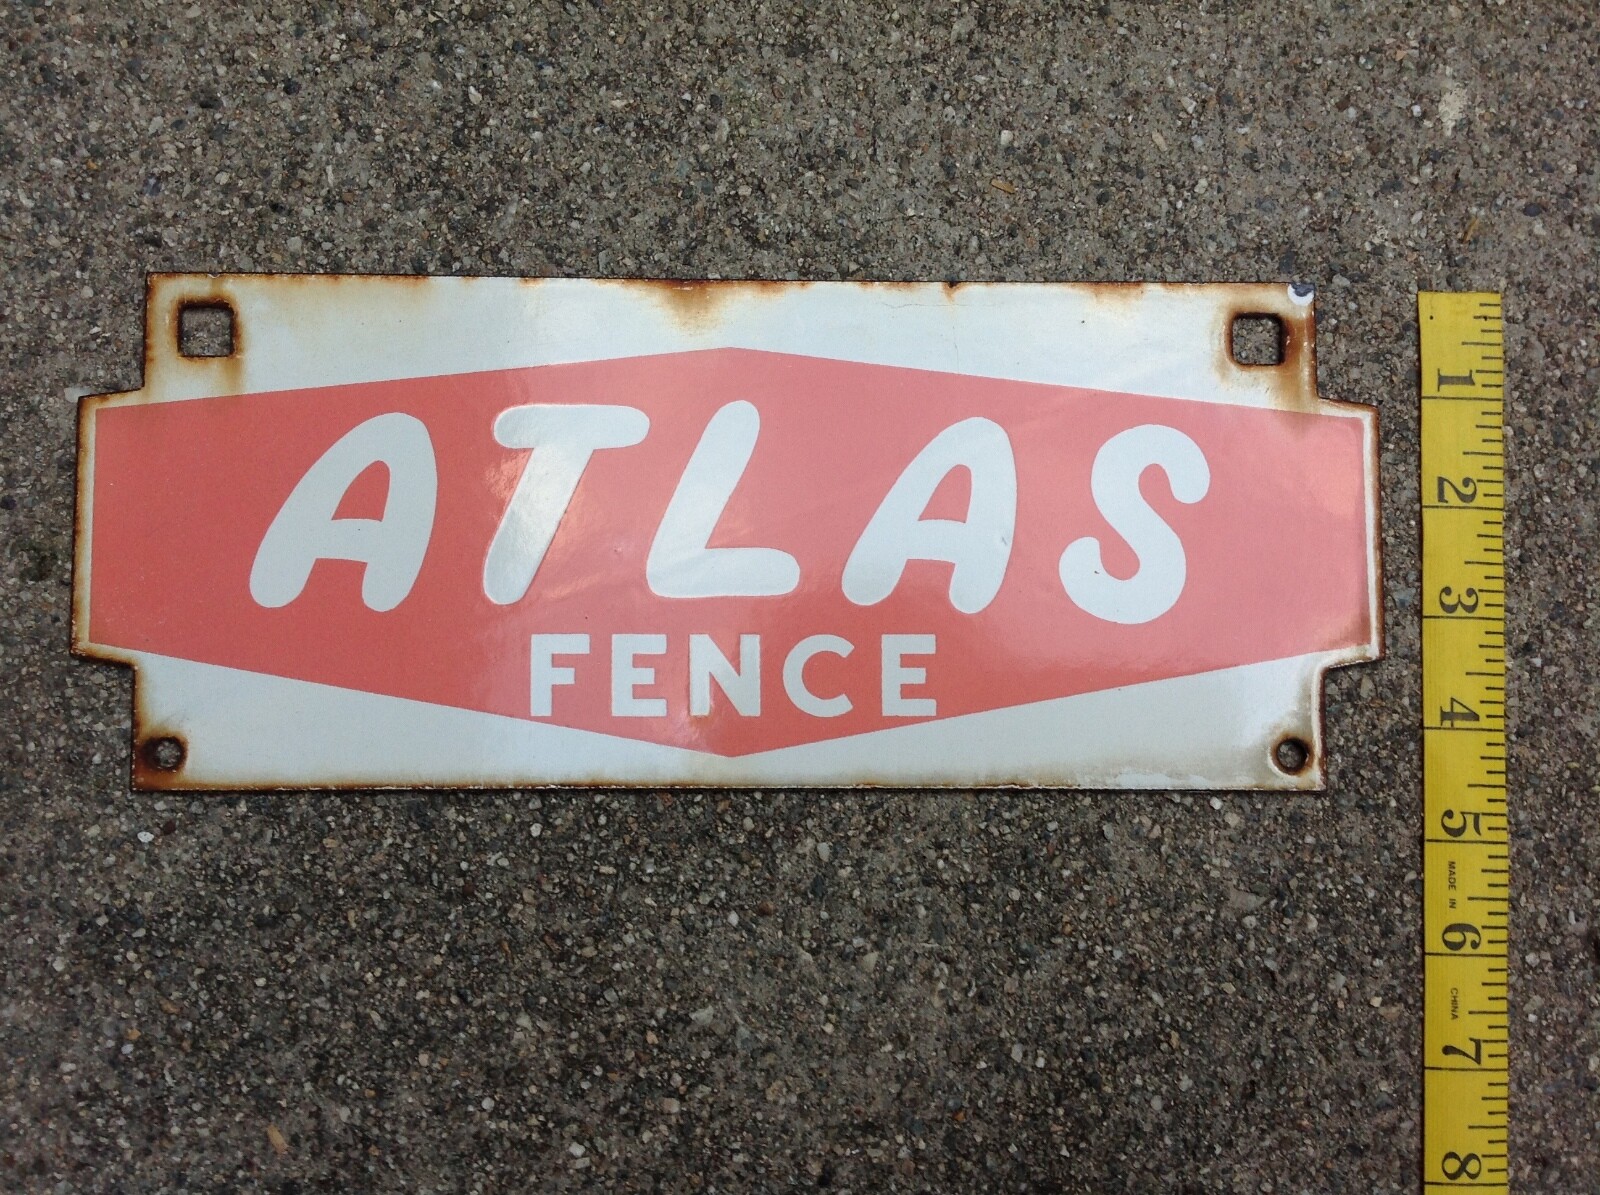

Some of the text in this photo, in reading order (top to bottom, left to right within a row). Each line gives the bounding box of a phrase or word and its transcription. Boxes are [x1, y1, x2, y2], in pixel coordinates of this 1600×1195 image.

[1437, 368, 1476, 392] 1
[1437, 476, 1477, 504] 2
[249, 399, 1212, 626] ATLAS
[1439, 586, 1479, 614] 3
[529, 633, 937, 718] FENCE
[1440, 697, 1480, 728] 4
[1440, 809, 1482, 839] 5
[1447, 860, 1457, 909] MADE IN
[1441, 922, 1482, 952] 6
[1450, 987, 1460, 1021] CHINA
[1441, 1037, 1482, 1066] 7
[1441, 1151, 1482, 1181] 8
